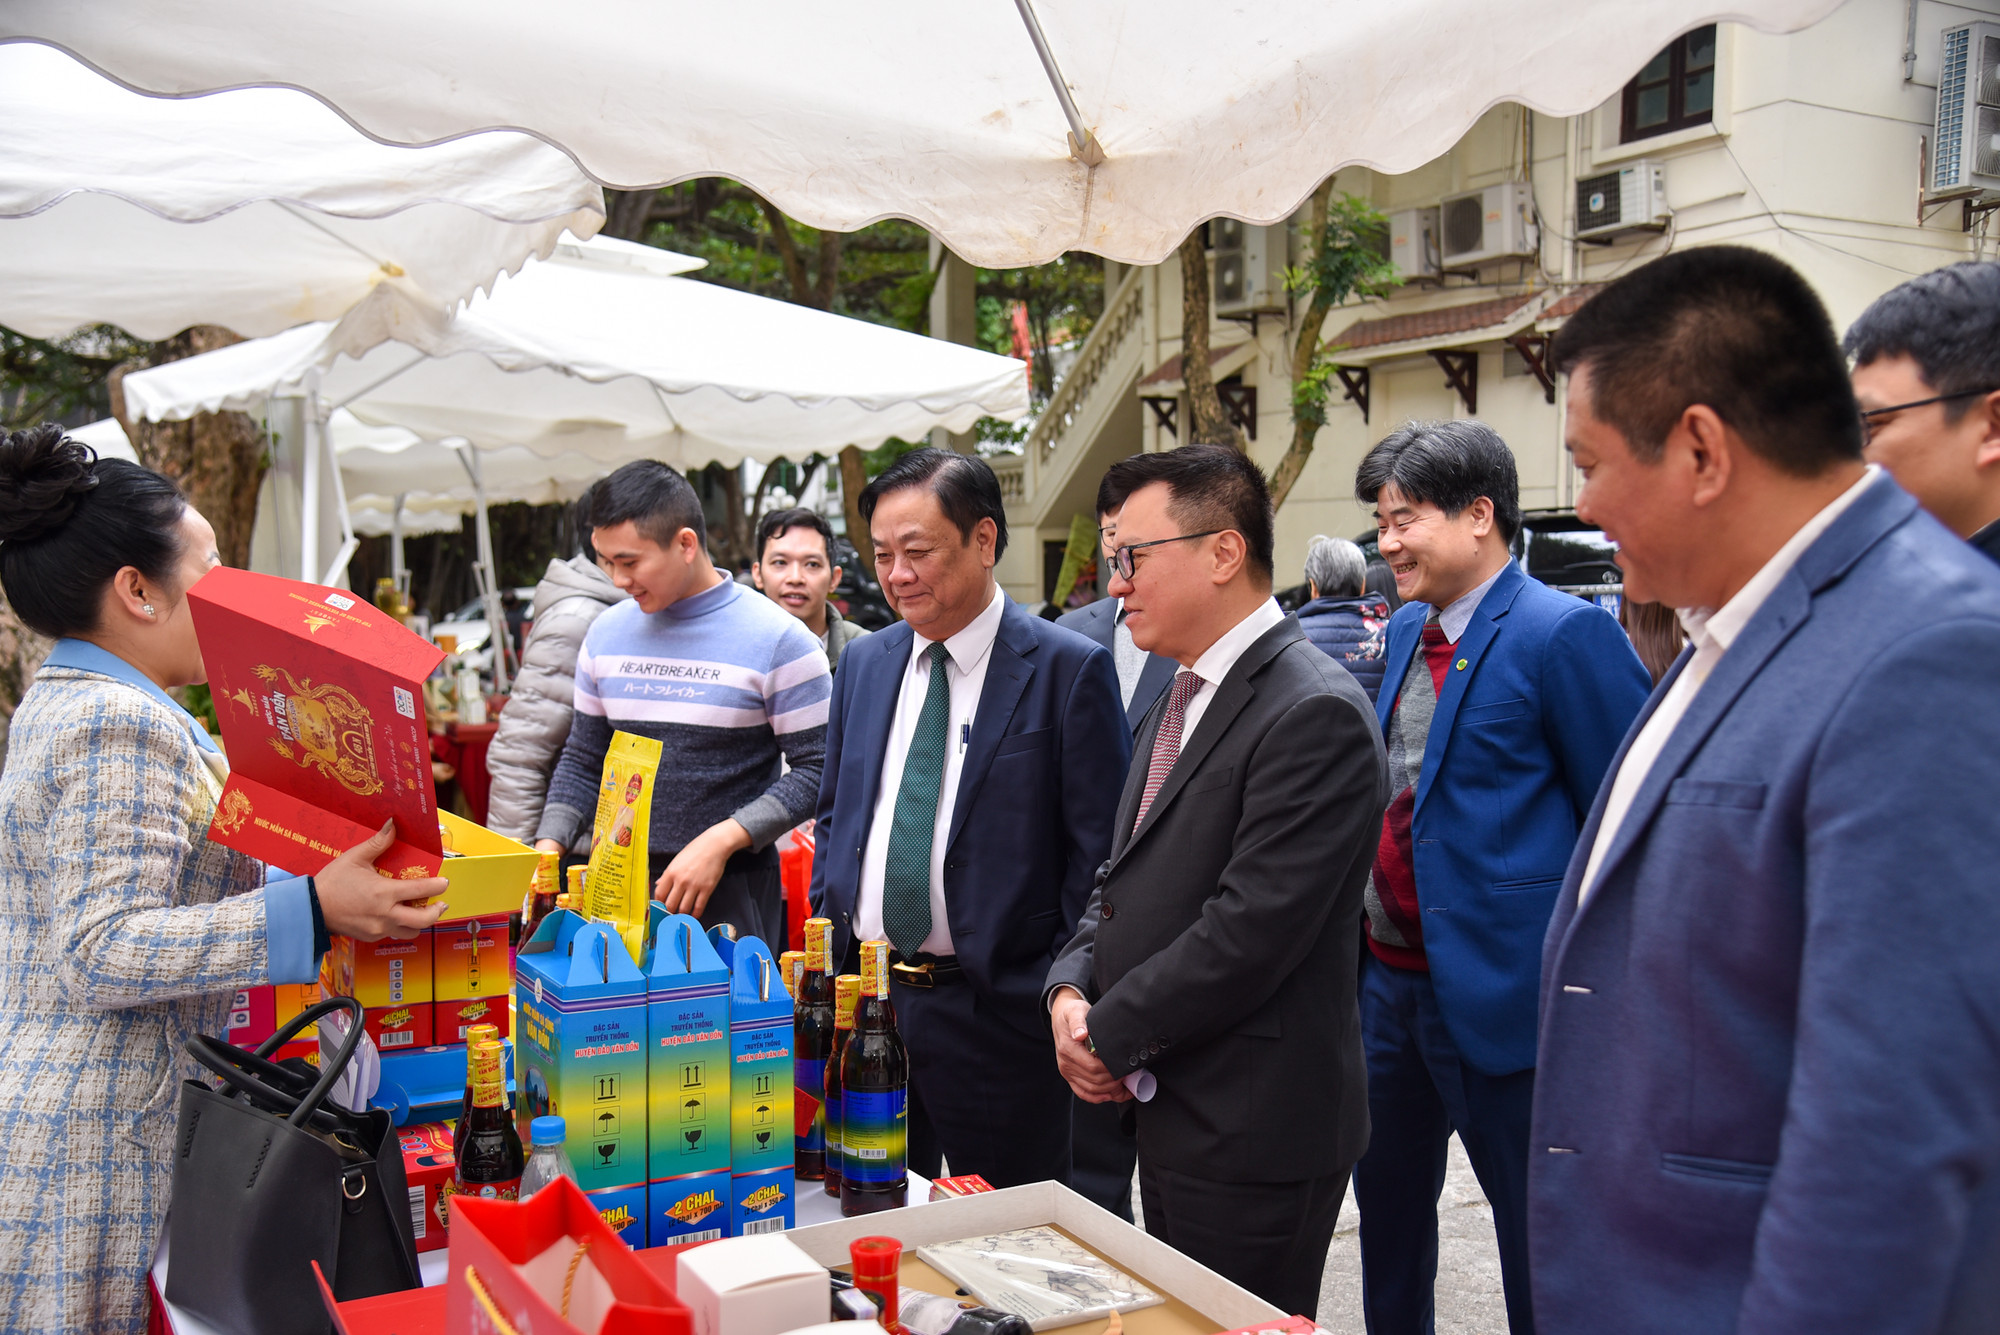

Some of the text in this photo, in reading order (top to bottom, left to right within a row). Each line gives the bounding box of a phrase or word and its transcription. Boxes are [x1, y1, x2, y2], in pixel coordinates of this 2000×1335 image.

[620, 661, 720, 680] HEARTBREAKER
[269, 690, 294, 741] VÂN ĐỒN
[269, 823, 284, 836] MẮM
[384, 1013, 391, 1024] 6
[391, 1008, 409, 1021] CHAI
[462, 1001, 486, 1016] 6 CHAI
[678, 1010, 704, 1022] ĐẶC SẢN
[594, 1021, 620, 1032] ĐẶC SẢN
[672, 1019, 714, 1032] TRUYỀN THỐNG
[586, 1030, 630, 1042] TRUYỀN THỐNG
[661, 1028, 722, 1046] HUYỆN ĐẢO VÂN ĐỒN
[763, 1031, 774, 1039] SẢN
[575, 1040, 639, 1058] HUYỆN ĐẢO VÂN ĐỒN
[744, 1039, 781, 1050] TRUYỀN THỐNG
[308, 1053, 320, 1064] CH
[736, 1047, 788, 1063] HUYỆN ĐẢO VÂN ĐỒN
[674, 1189, 715, 1216] 2 CHAI
[748, 1184, 780, 1206] 2 CHAI
[600, 1204, 628, 1224] CHAI
[751, 1205, 763, 1214] Chai
[768, 1198, 779, 1207] 350
[676, 1215, 692, 1225] Chai
[700, 1206, 712, 1216] 700
[613, 1222, 625, 1231] 700
